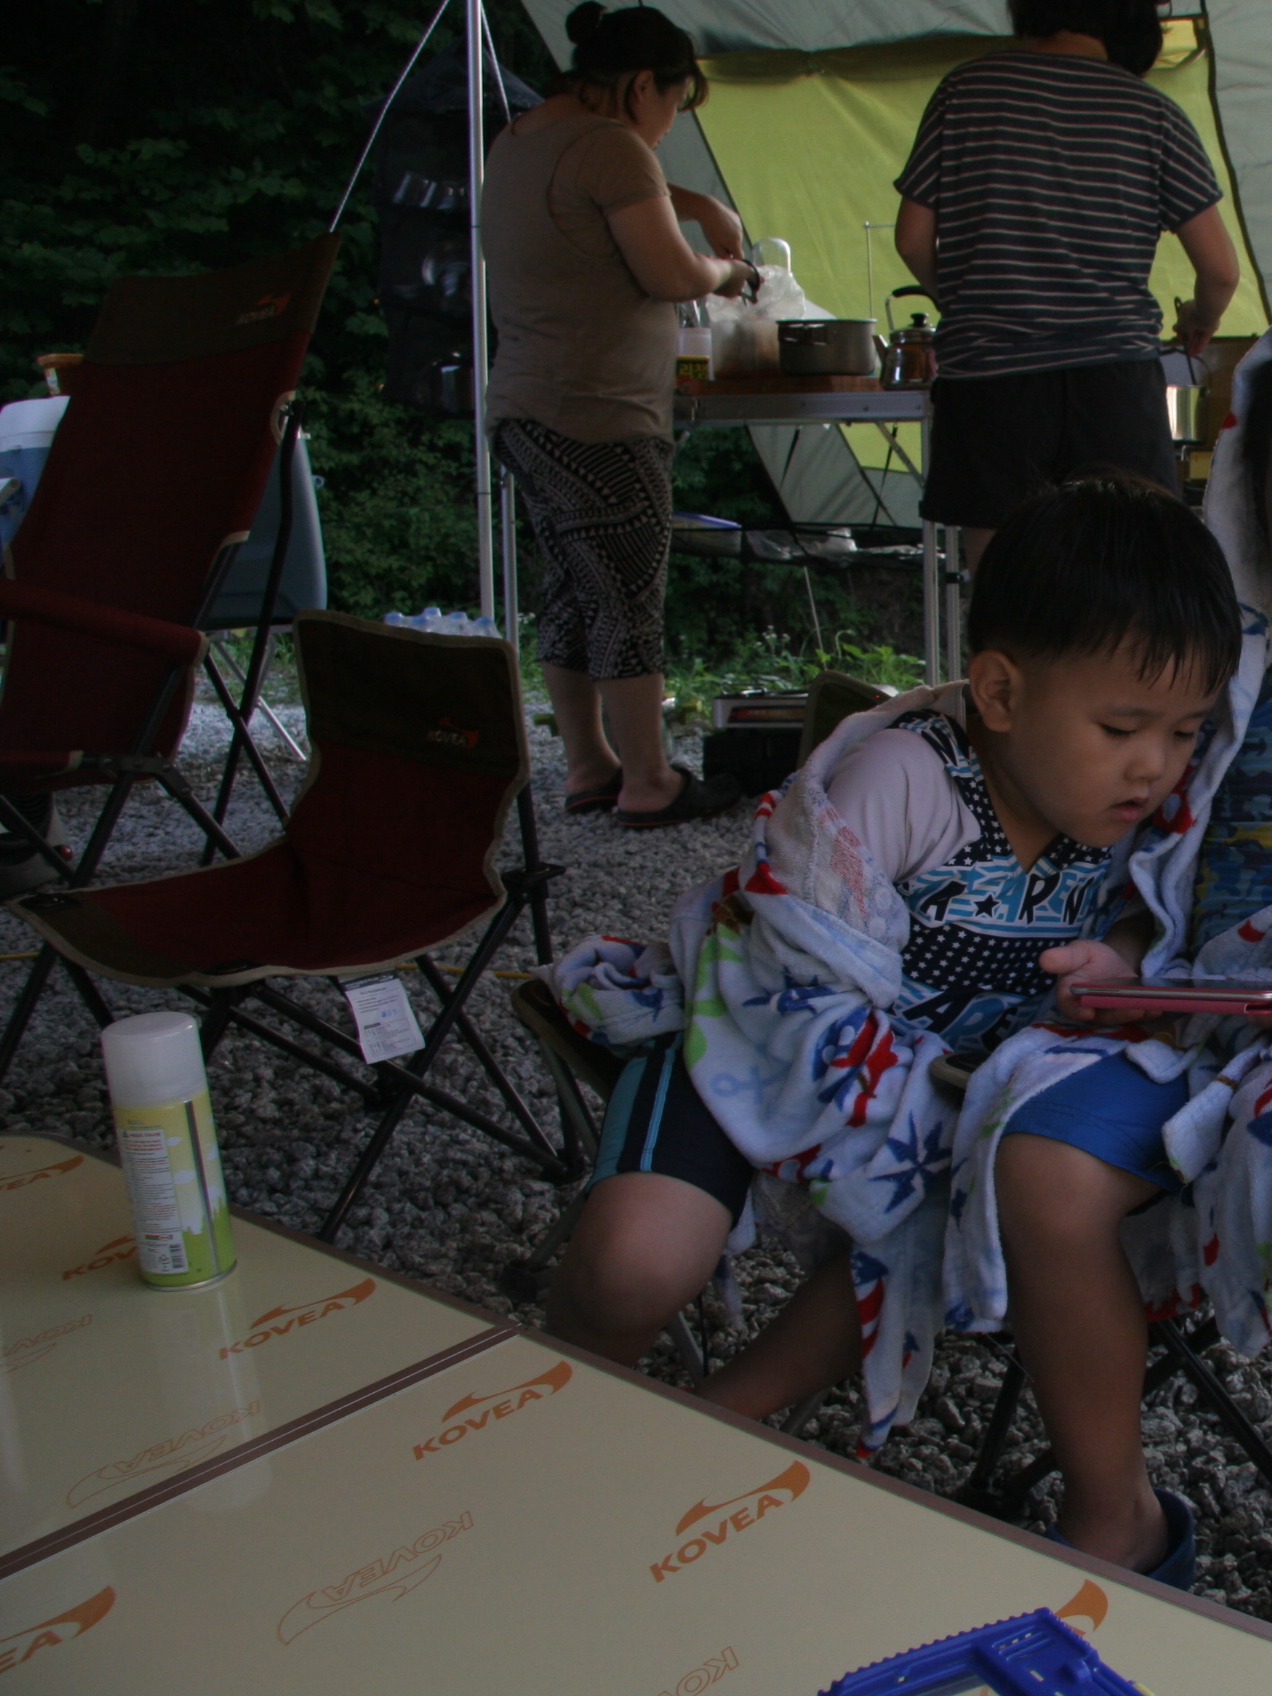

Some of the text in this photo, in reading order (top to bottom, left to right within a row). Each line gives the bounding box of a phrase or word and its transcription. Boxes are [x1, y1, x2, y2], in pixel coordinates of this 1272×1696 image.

[218, 1301, 345, 1360] KOVEA
[114, 1401, 259, 1474] KOVEA
[412, 1388, 543, 1460] KOVEA
[322, 1512, 474, 1603] KOVEA
[650, 1494, 784, 1583] KOVEA
